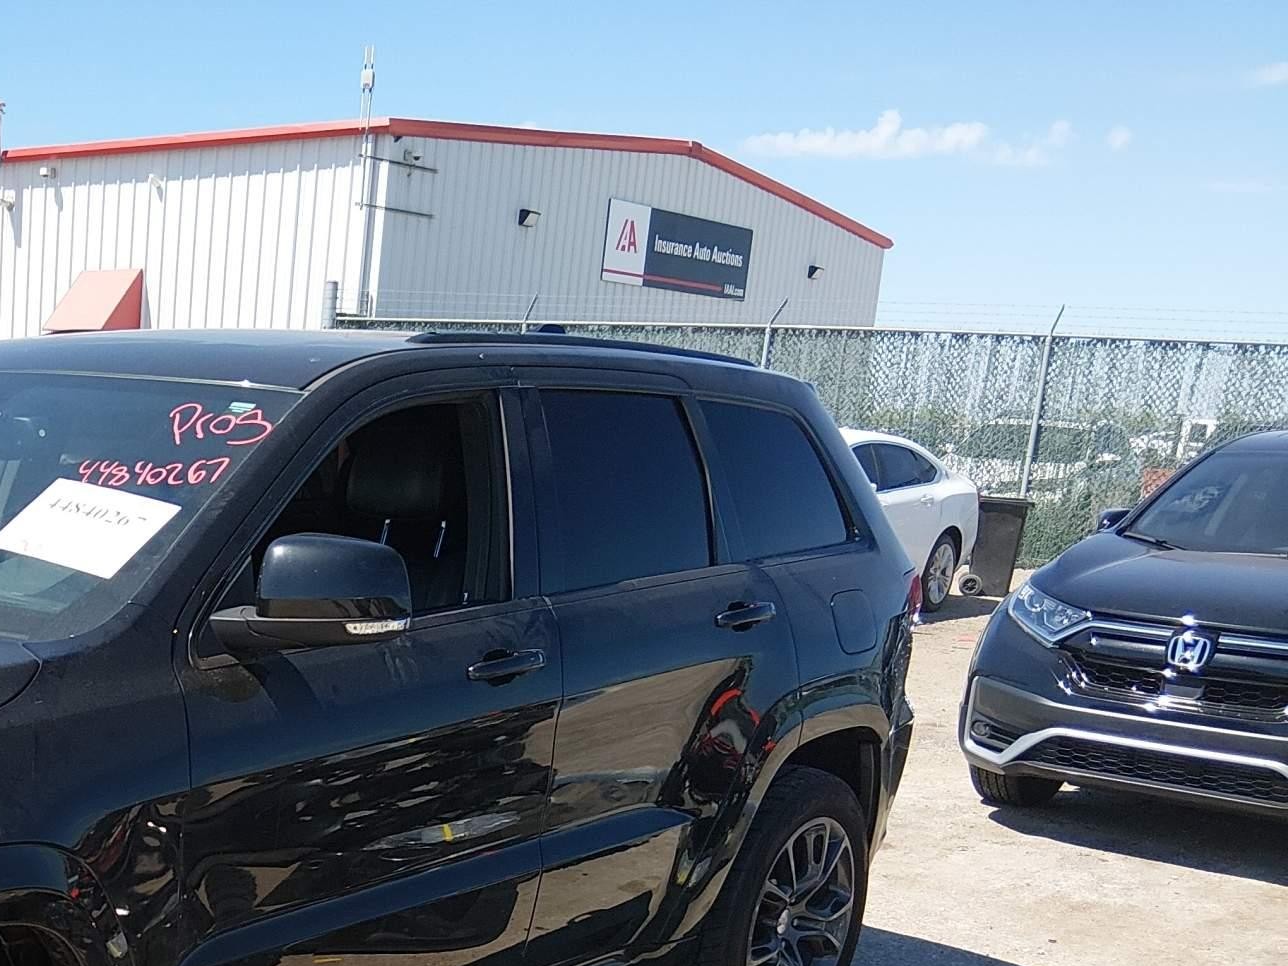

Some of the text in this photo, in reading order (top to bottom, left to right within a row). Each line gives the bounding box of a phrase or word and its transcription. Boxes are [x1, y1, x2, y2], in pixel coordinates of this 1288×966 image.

[653, 234, 744, 268] Insurance Auto Auctions
[77, 456, 231, 487] 44840267
